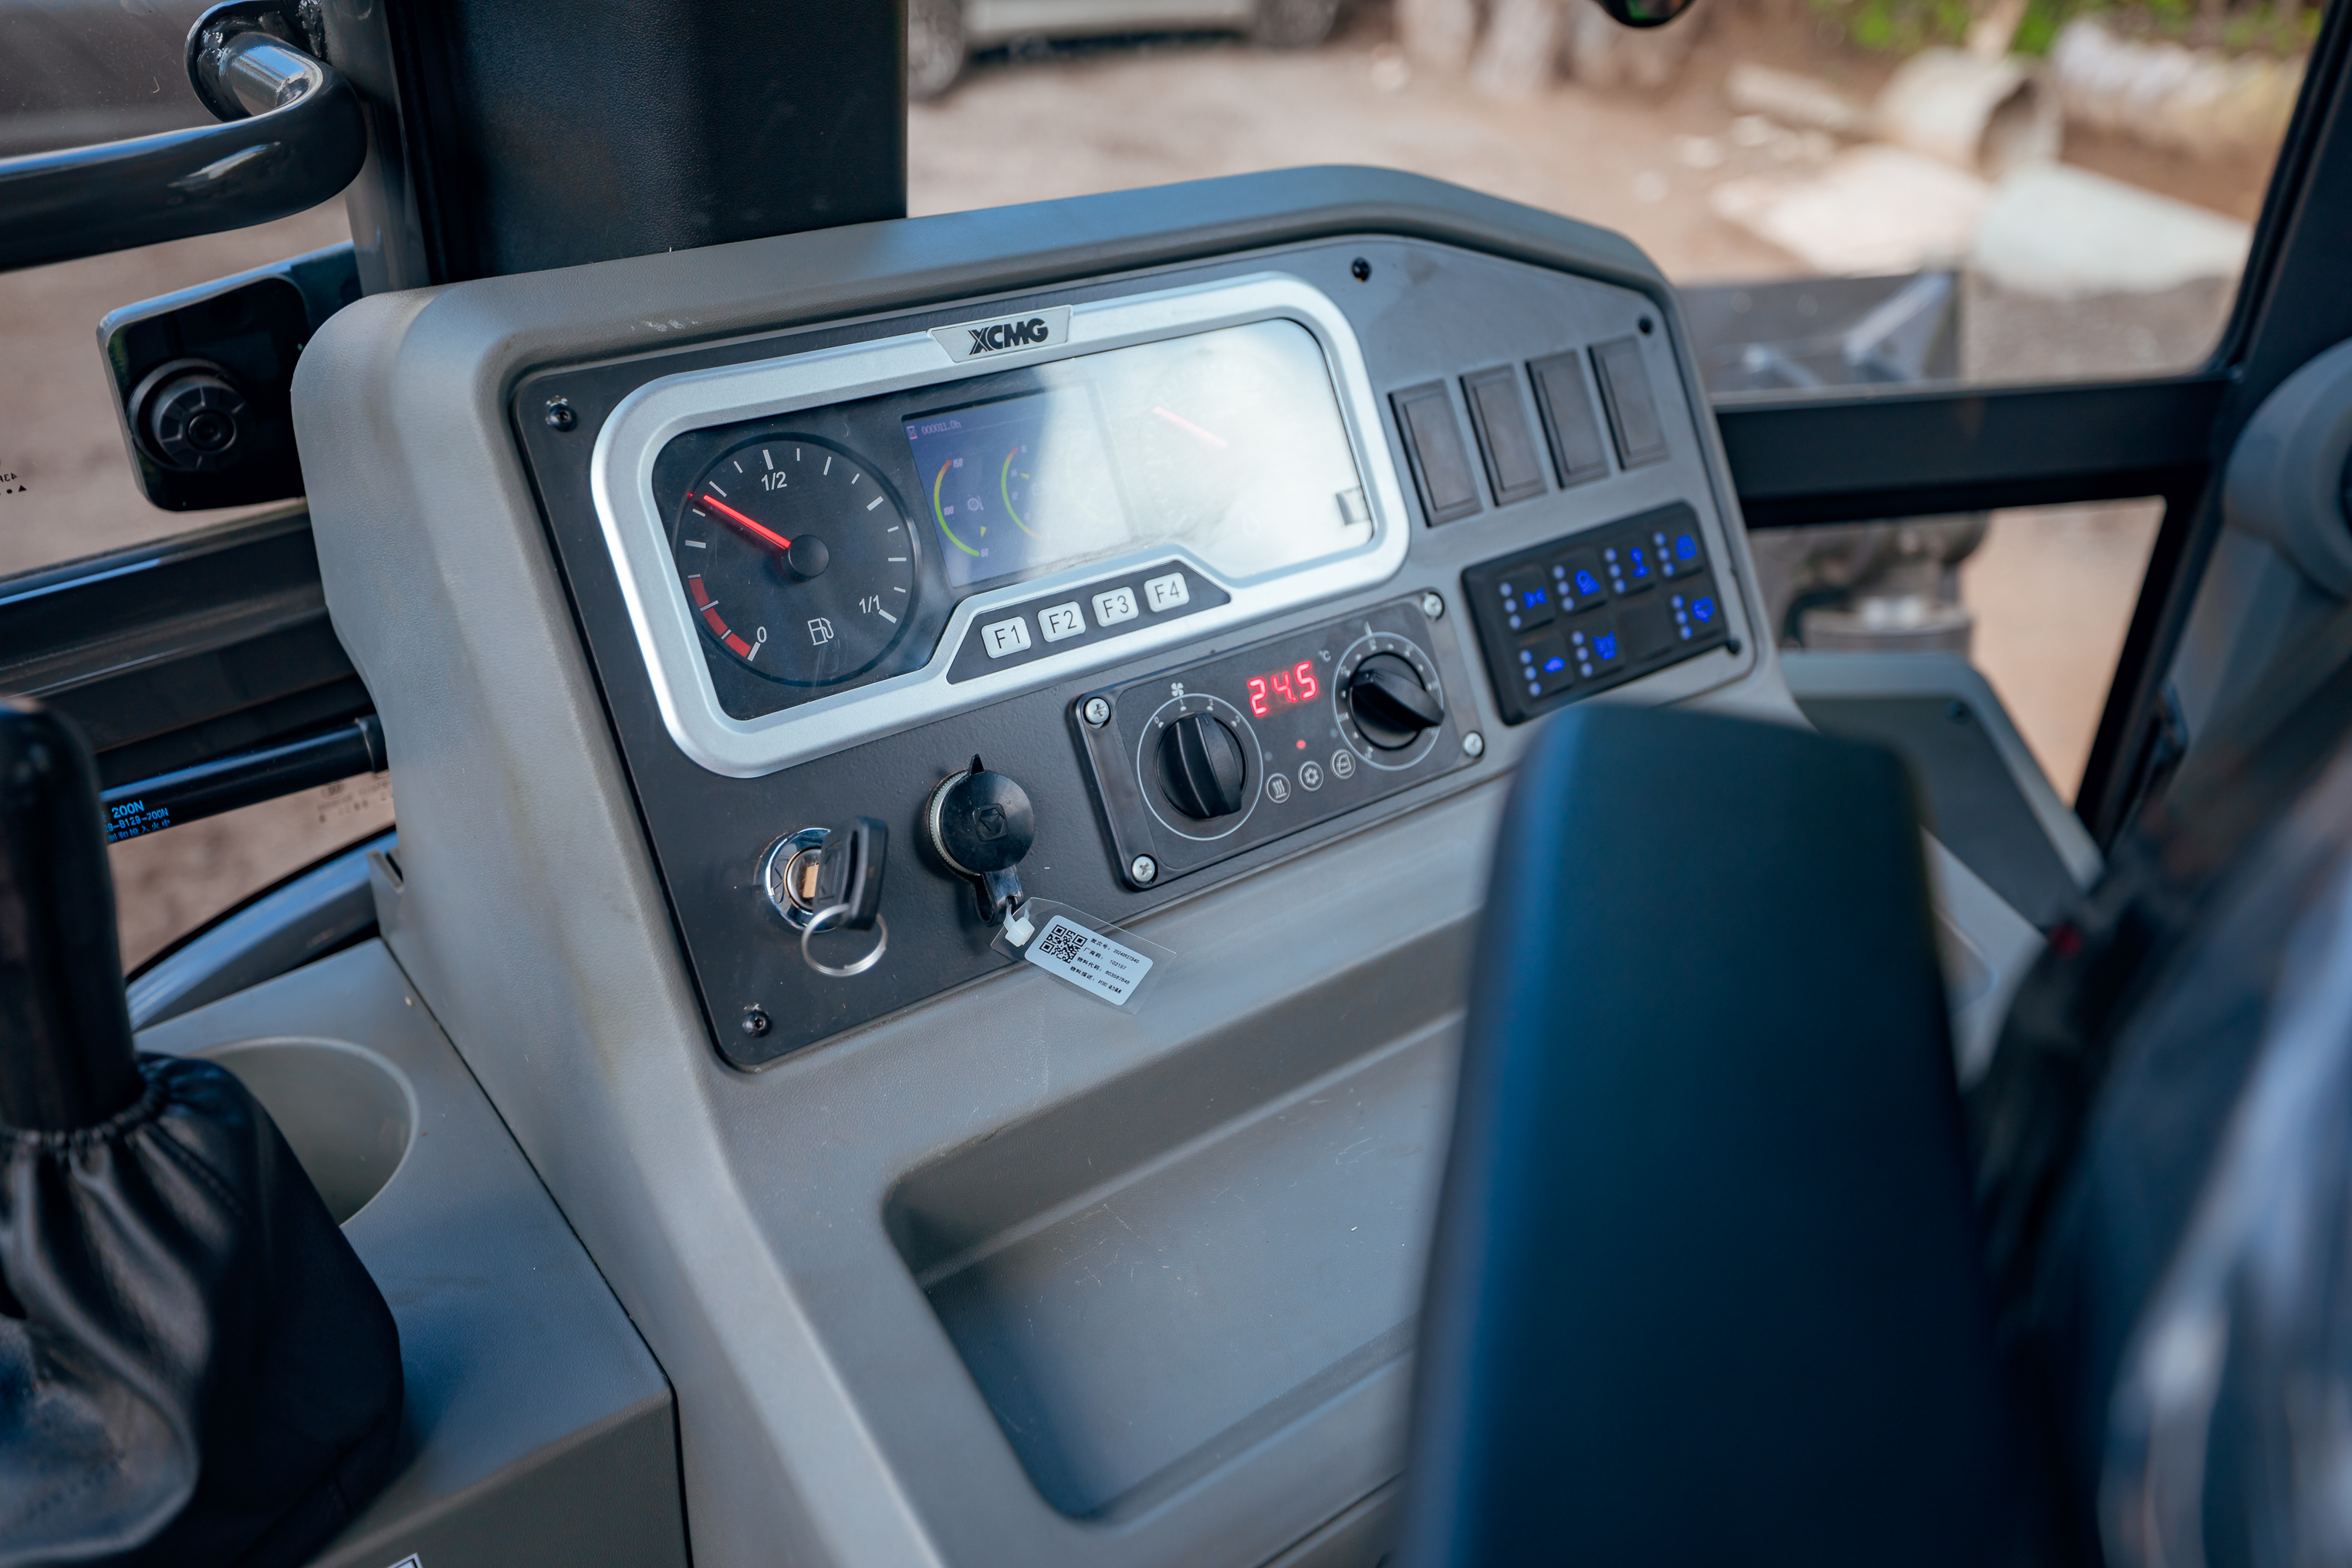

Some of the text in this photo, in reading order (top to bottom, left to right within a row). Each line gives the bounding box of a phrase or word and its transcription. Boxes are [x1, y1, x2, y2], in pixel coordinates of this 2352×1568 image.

[967, 317, 1049, 355] XCMG
[921, 420, 961, 434] 000011.0h
[953, 458, 963, 468] 150
[761, 471, 787, 491] 1/2
[944, 505, 954, 516] 100
[1154, 580, 1180, 603] F4
[859, 594, 880, 613] 1/1
[1103, 595, 1129, 618] F3
[1048, 610, 1077, 634] F2
[757, 626, 767, 643] 0
[994, 625, 1021, 649] F1
[1247, 661, 1317, 716] 24.5
[111, 799, 145, 819] 200N
[1109, 959, 1127, 970] 102157
